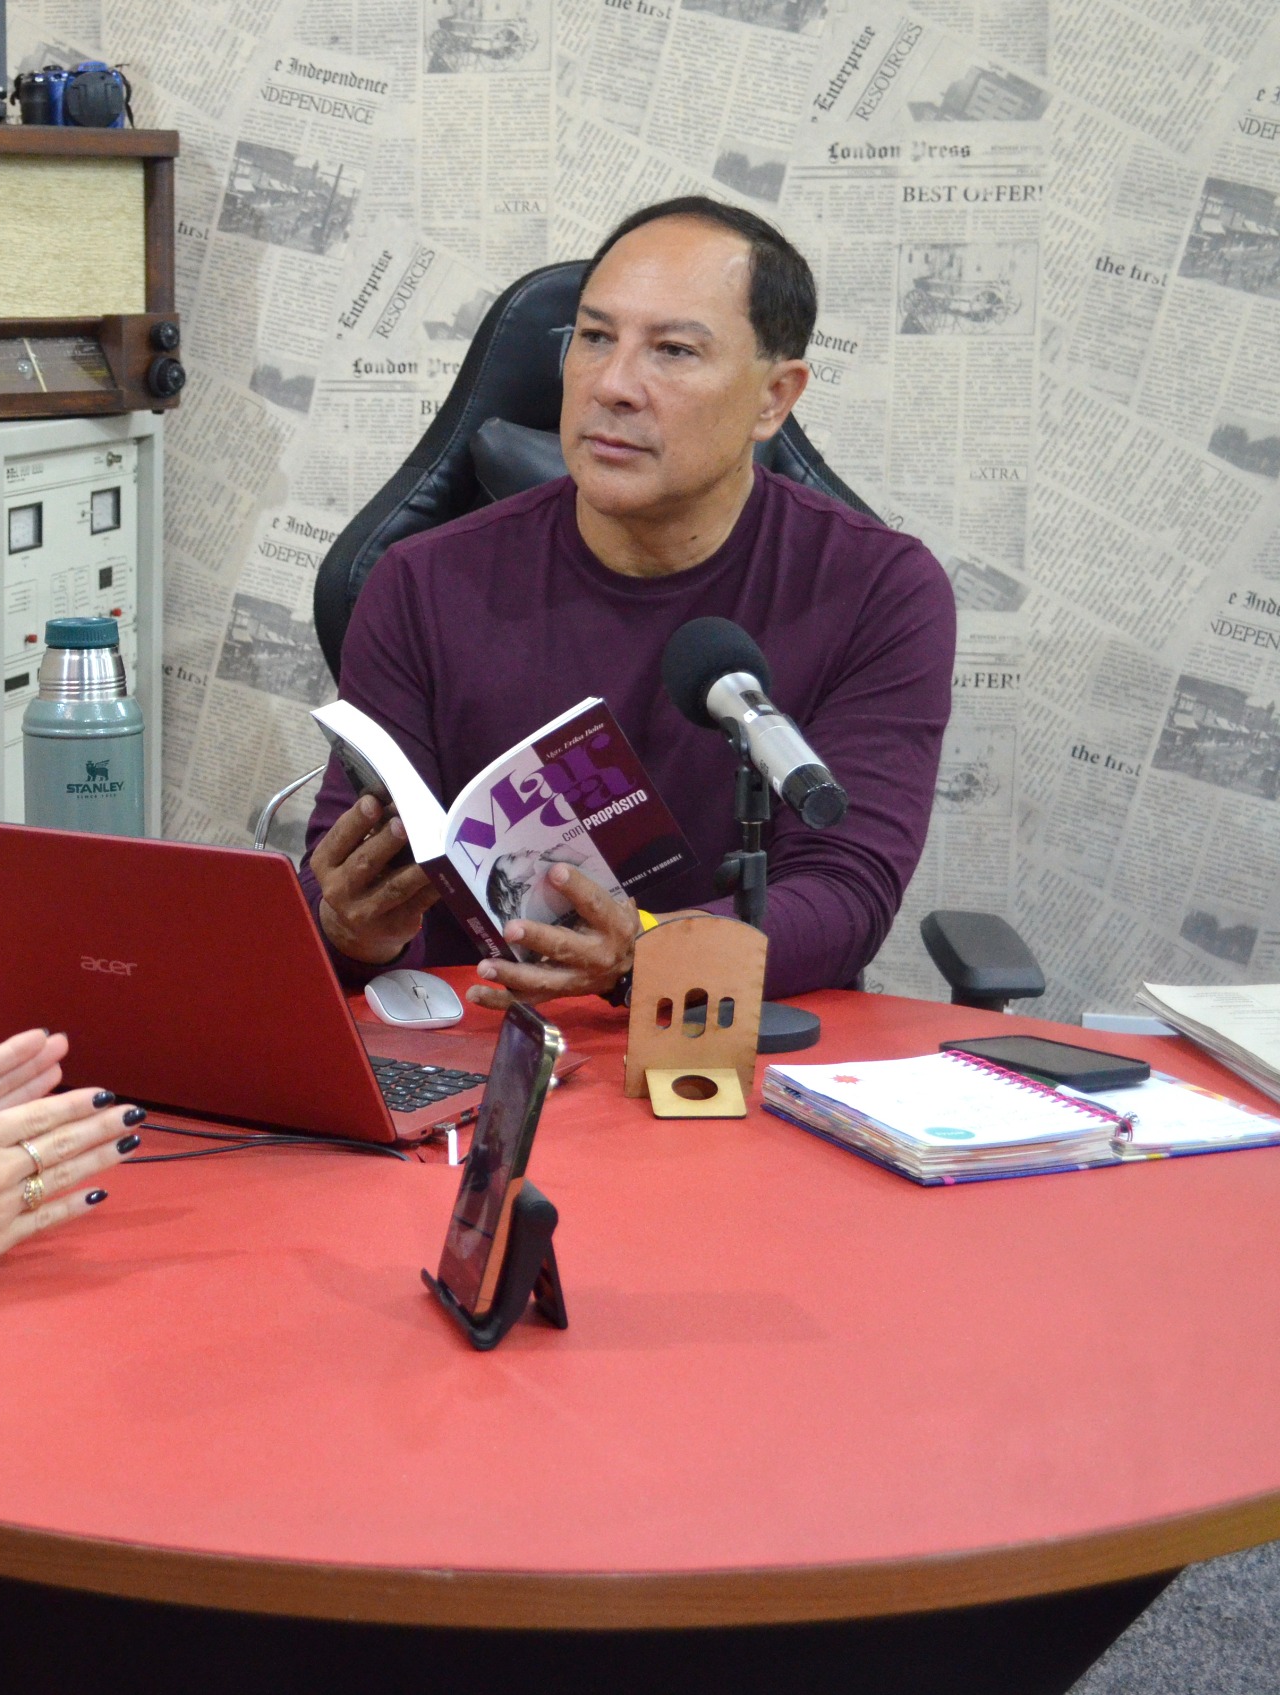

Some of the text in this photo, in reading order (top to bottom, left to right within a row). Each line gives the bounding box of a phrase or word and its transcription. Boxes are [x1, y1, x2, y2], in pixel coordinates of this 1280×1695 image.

[288, 57, 389, 96] Independence
[813, 25, 876, 111] Enterprise
[856, 22, 923, 122] RESOURCES
[828, 142, 902, 164] London
[911, 140, 972, 162] Press
[903, 185, 1044, 202] BEST OFFER!
[1095, 256, 1125, 276] the
[339, 249, 394, 330] Enterprise
[376, 246, 437, 340] RESOURCES
[353, 357, 418, 378] London
[564, 735, 585, 750] Erika
[1071, 745, 1100, 764] the
[66, 781, 124, 793] STANLEY
[562, 788, 649, 843] con PROPÓSITO
[80, 955, 137, 976] acer
